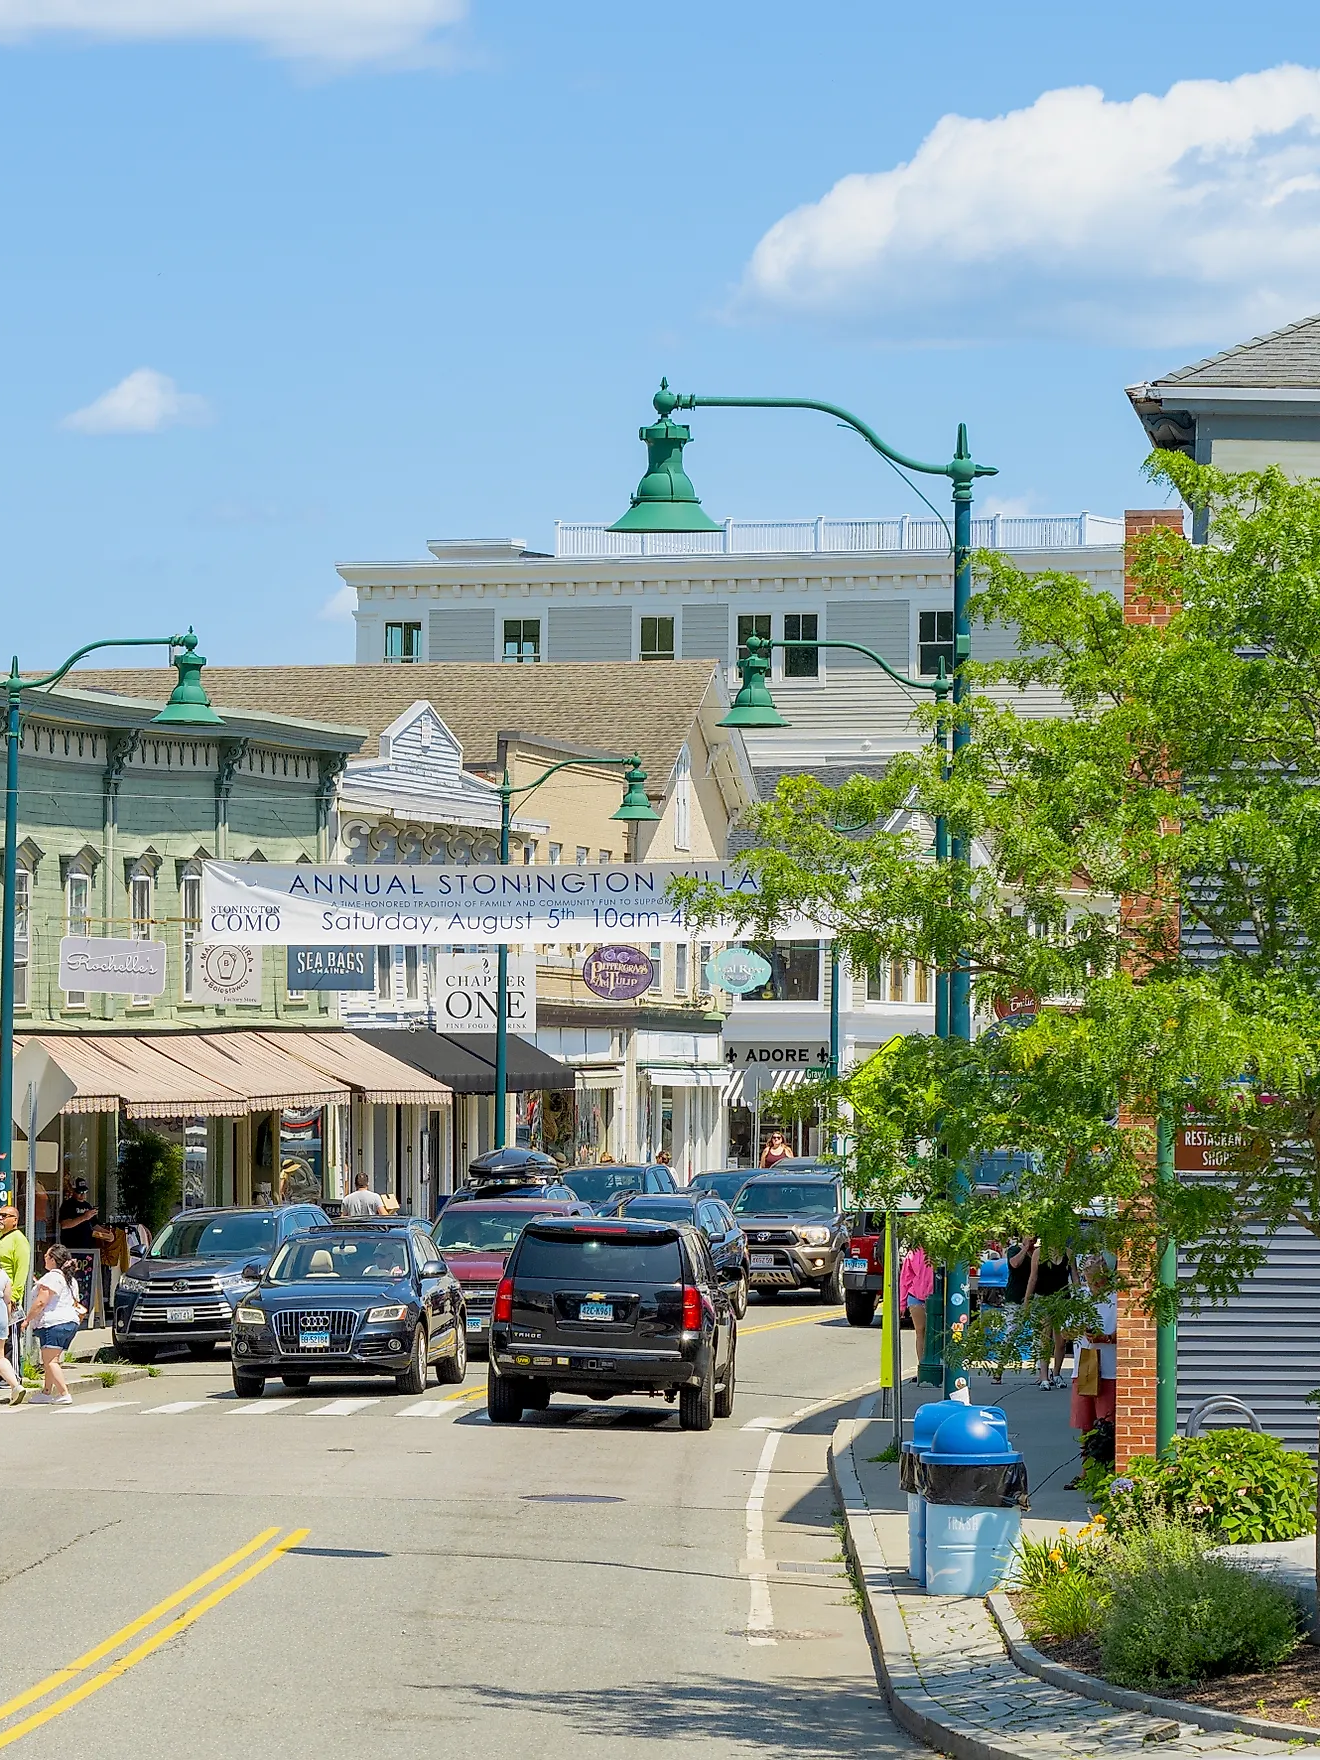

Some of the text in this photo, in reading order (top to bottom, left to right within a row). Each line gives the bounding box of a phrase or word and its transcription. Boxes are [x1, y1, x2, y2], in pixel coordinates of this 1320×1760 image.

[288, 869, 758, 895] ANNUAL STONINGTON VILLA
[210, 905, 281, 914] STONINGTON
[341, 900, 411, 908] TIME-HONORED
[413, 900, 461, 908] TRADITION
[539, 899, 596, 907] COMMUNITY
[598, 898, 616, 906] FUN
[634, 897, 673, 905] SUPPOR
[210, 913, 280, 932] COMO
[321, 911, 439, 934] Saturday,
[448, 911, 533, 934] August
[546, 907, 575, 929] 5th
[66, 951, 158, 975] Rochelle's
[297, 951, 364, 974] SEA BAGS
[445, 975, 527, 987] CHAPER
[606, 971, 638, 996] TULIP
[444, 990, 528, 1019] ONE
[745, 1048, 810, 1062] ADORE
[947, 1516, 979, 1531] TRASH
